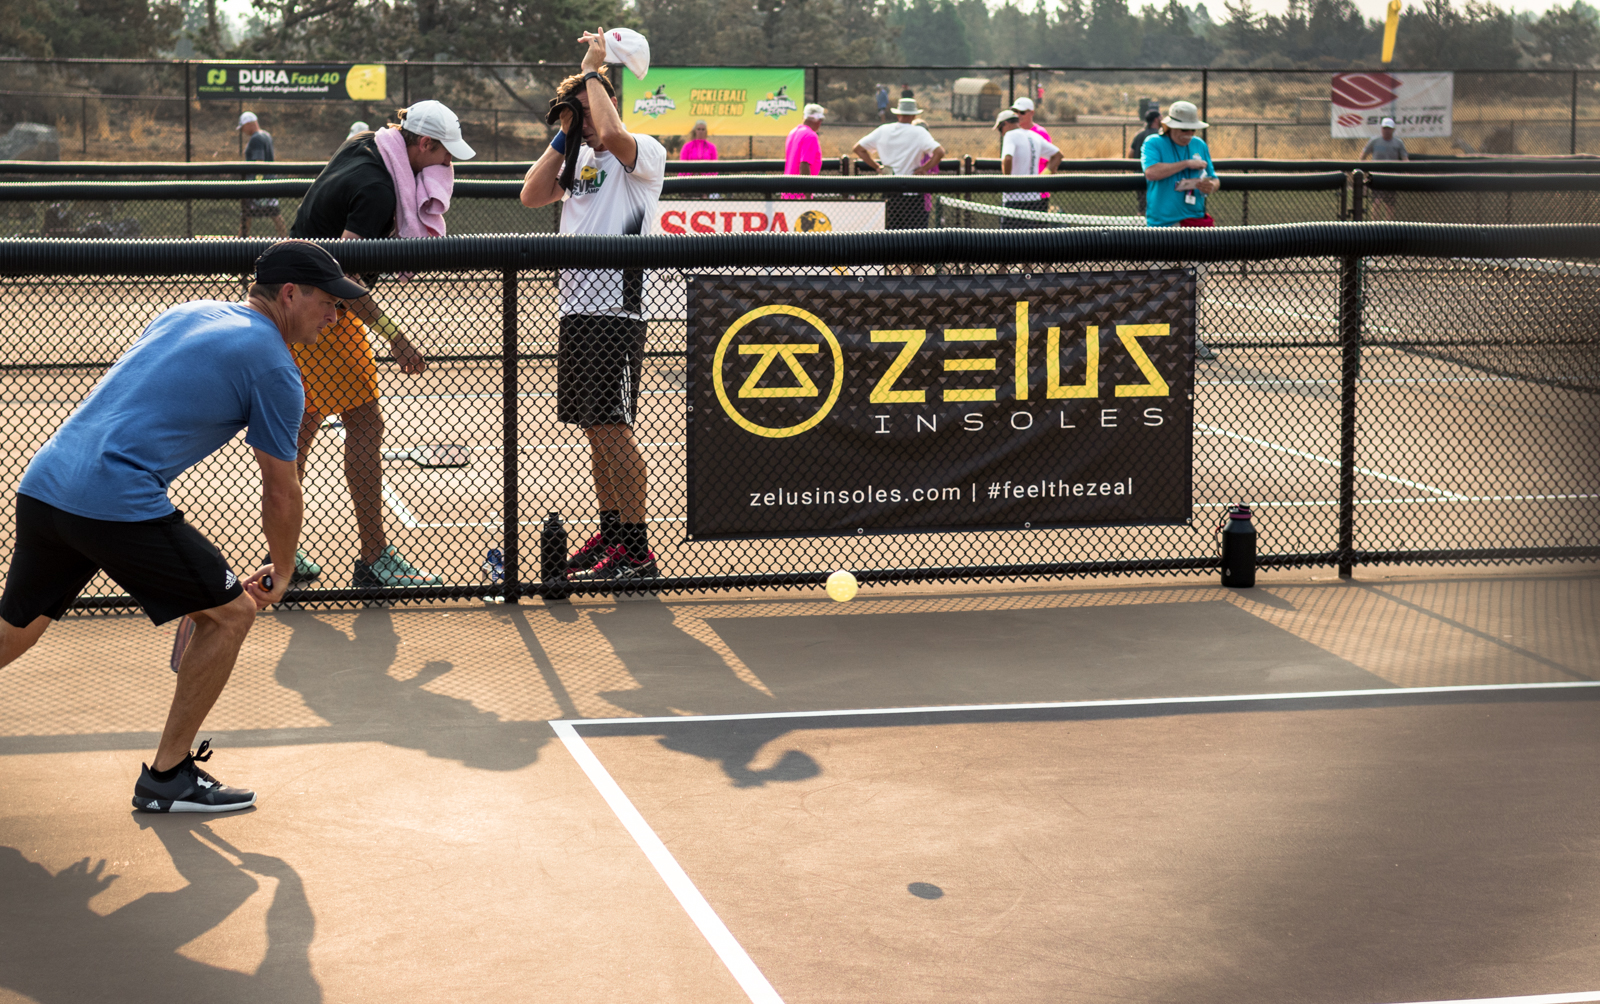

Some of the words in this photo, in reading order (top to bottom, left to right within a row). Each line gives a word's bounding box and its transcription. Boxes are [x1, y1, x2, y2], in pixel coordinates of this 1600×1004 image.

[239, 69, 289, 84] DURA
[291, 72, 319, 85] Fast
[320, 72, 340, 85] 40
[273, 85, 298, 93] Original
[690, 89, 747, 102] PICKLEBALL
[690, 103, 716, 116] ZONE
[718, 103, 744, 116] BEND
[874, 407, 1164, 434] INSOLES
[749, 482, 961, 507] zelusinsoles.com
[987, 477, 1133, 501] #feelthezeal
